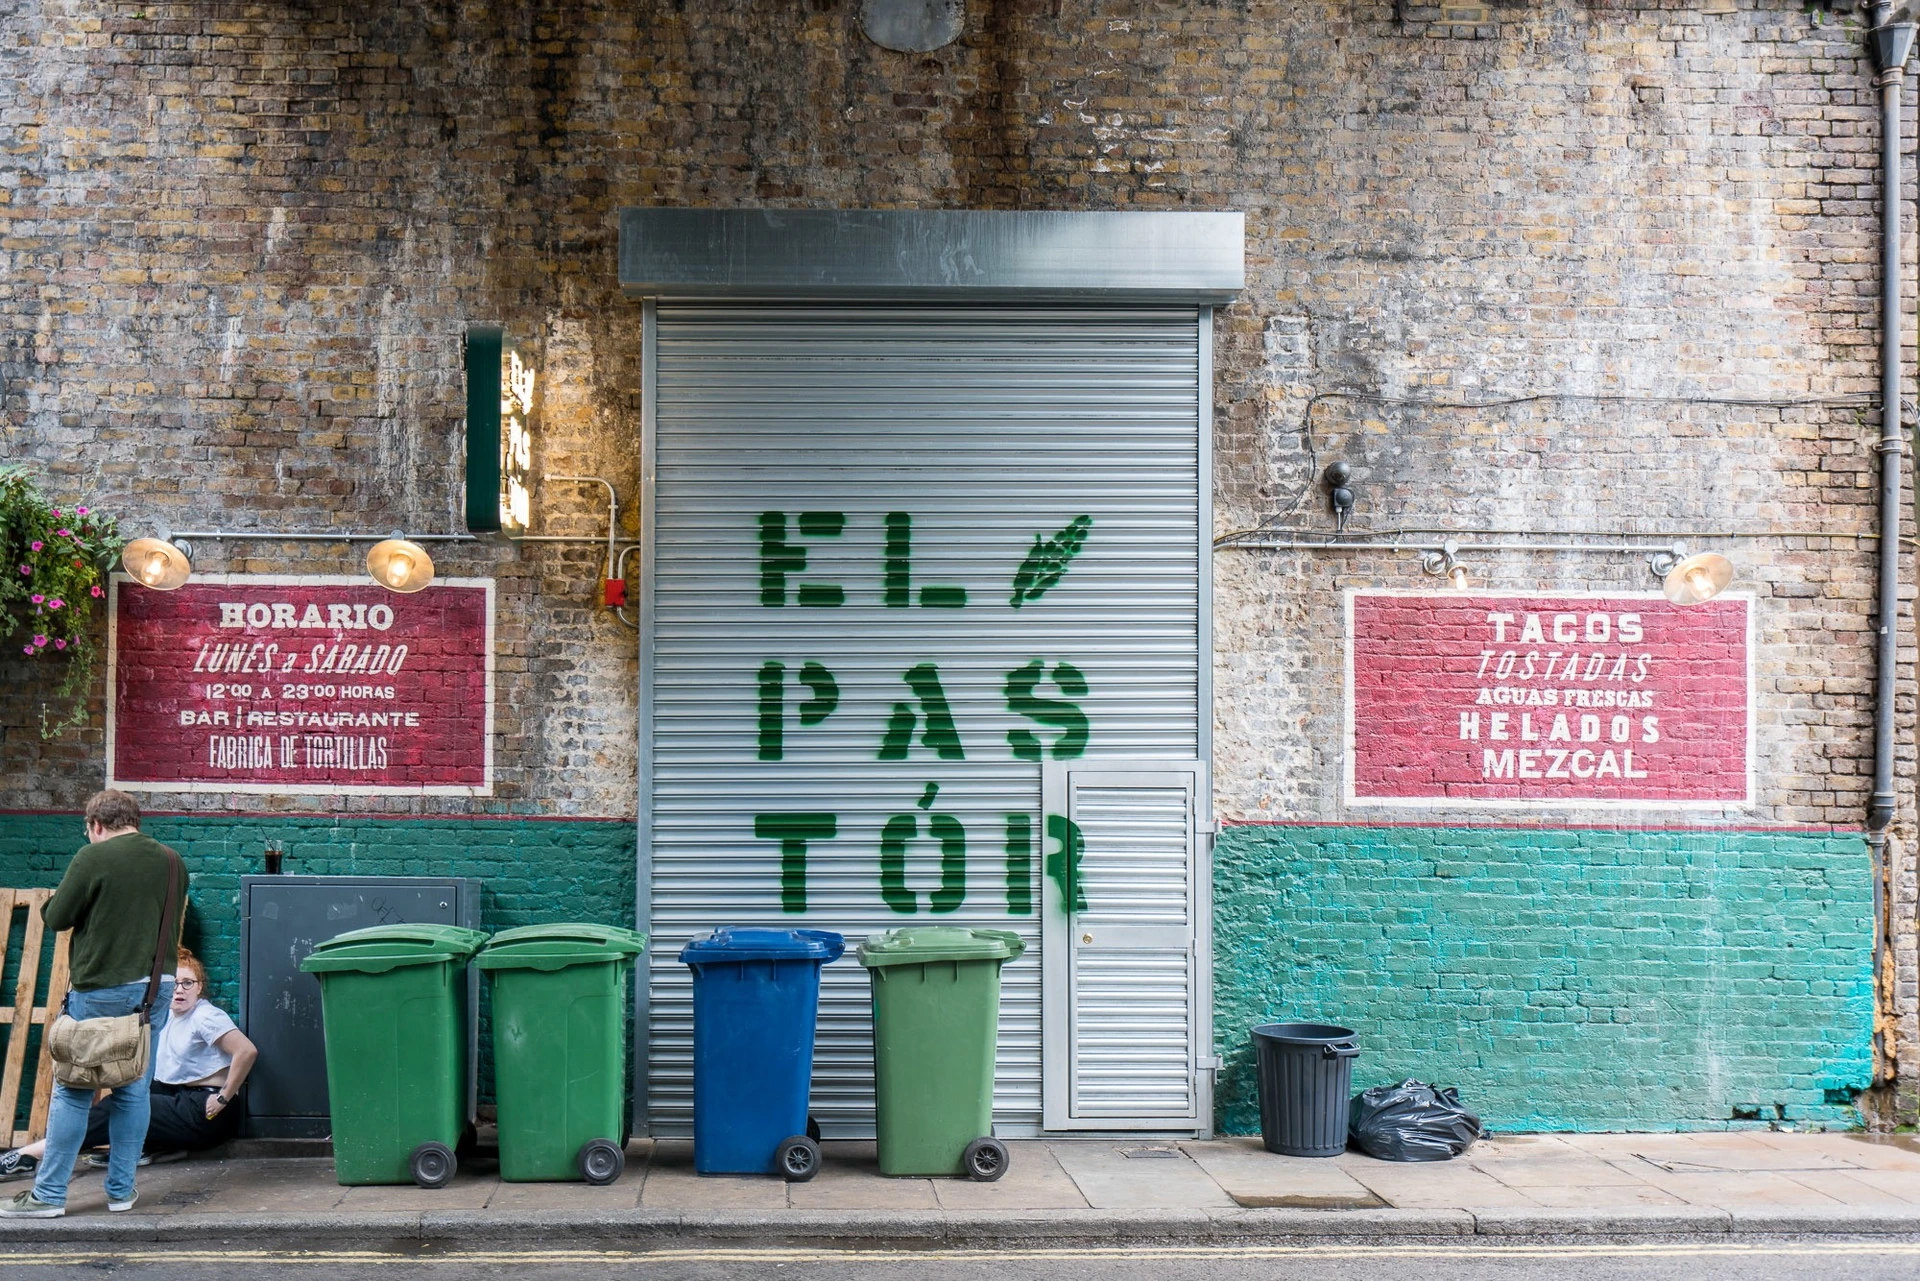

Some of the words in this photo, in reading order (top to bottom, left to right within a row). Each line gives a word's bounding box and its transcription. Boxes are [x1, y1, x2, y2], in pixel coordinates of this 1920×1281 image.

[758, 510, 967, 608] EL
[219, 603, 394, 631] HORARIO
[1486, 613, 1644, 643] TACOS
[193, 643, 279, 673] LUNES
[304, 633, 408, 675] SÁBADO
[1476, 650, 1652, 682] TOSTADAS
[261, 689, 272, 699] A
[341, 686, 395, 699] HORAS
[1475, 686, 1559, 706] AGUAS
[1563, 689, 1654, 708] FRESCAS
[180, 710, 230, 725] BAR
[247, 711, 420, 727] RESTAURANTE
[757, 660, 1090, 761] PAS
[1459, 711, 1660, 744] HELADOS
[209, 735, 272, 769] FABRICA
[280, 735, 298, 768] DE
[304, 735, 388, 770] TORTILLAS
[1483, 749, 1648, 778] MEZCAL
[754, 782, 1089, 914] TÓR
